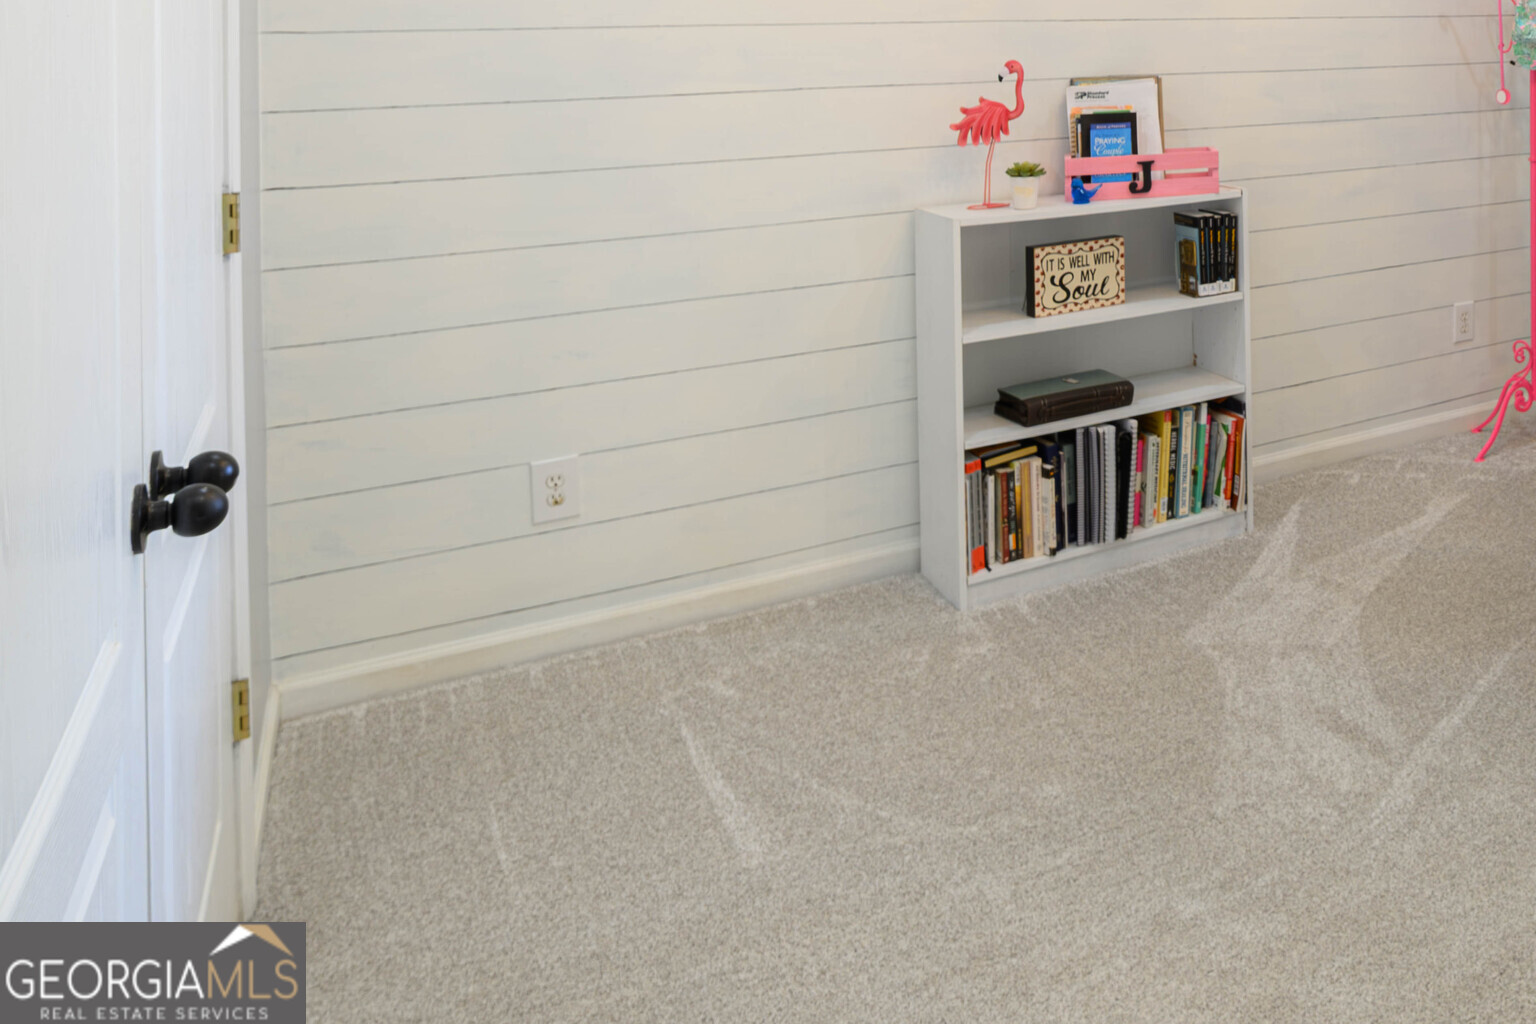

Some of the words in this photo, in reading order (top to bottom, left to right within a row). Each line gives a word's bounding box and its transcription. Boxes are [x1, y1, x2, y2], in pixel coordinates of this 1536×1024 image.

[1094, 136, 1125, 145] PRAYING
[1128, 160, 1155, 194] J
[1046, 258, 1054, 272] IT
[1057, 257, 1065, 271] IS
[1069, 254, 1090, 269] WELL
[1093, 250, 1115, 265] WITH
[1080, 268, 1096, 283] MY
[1050, 271, 1110, 303] Soul
